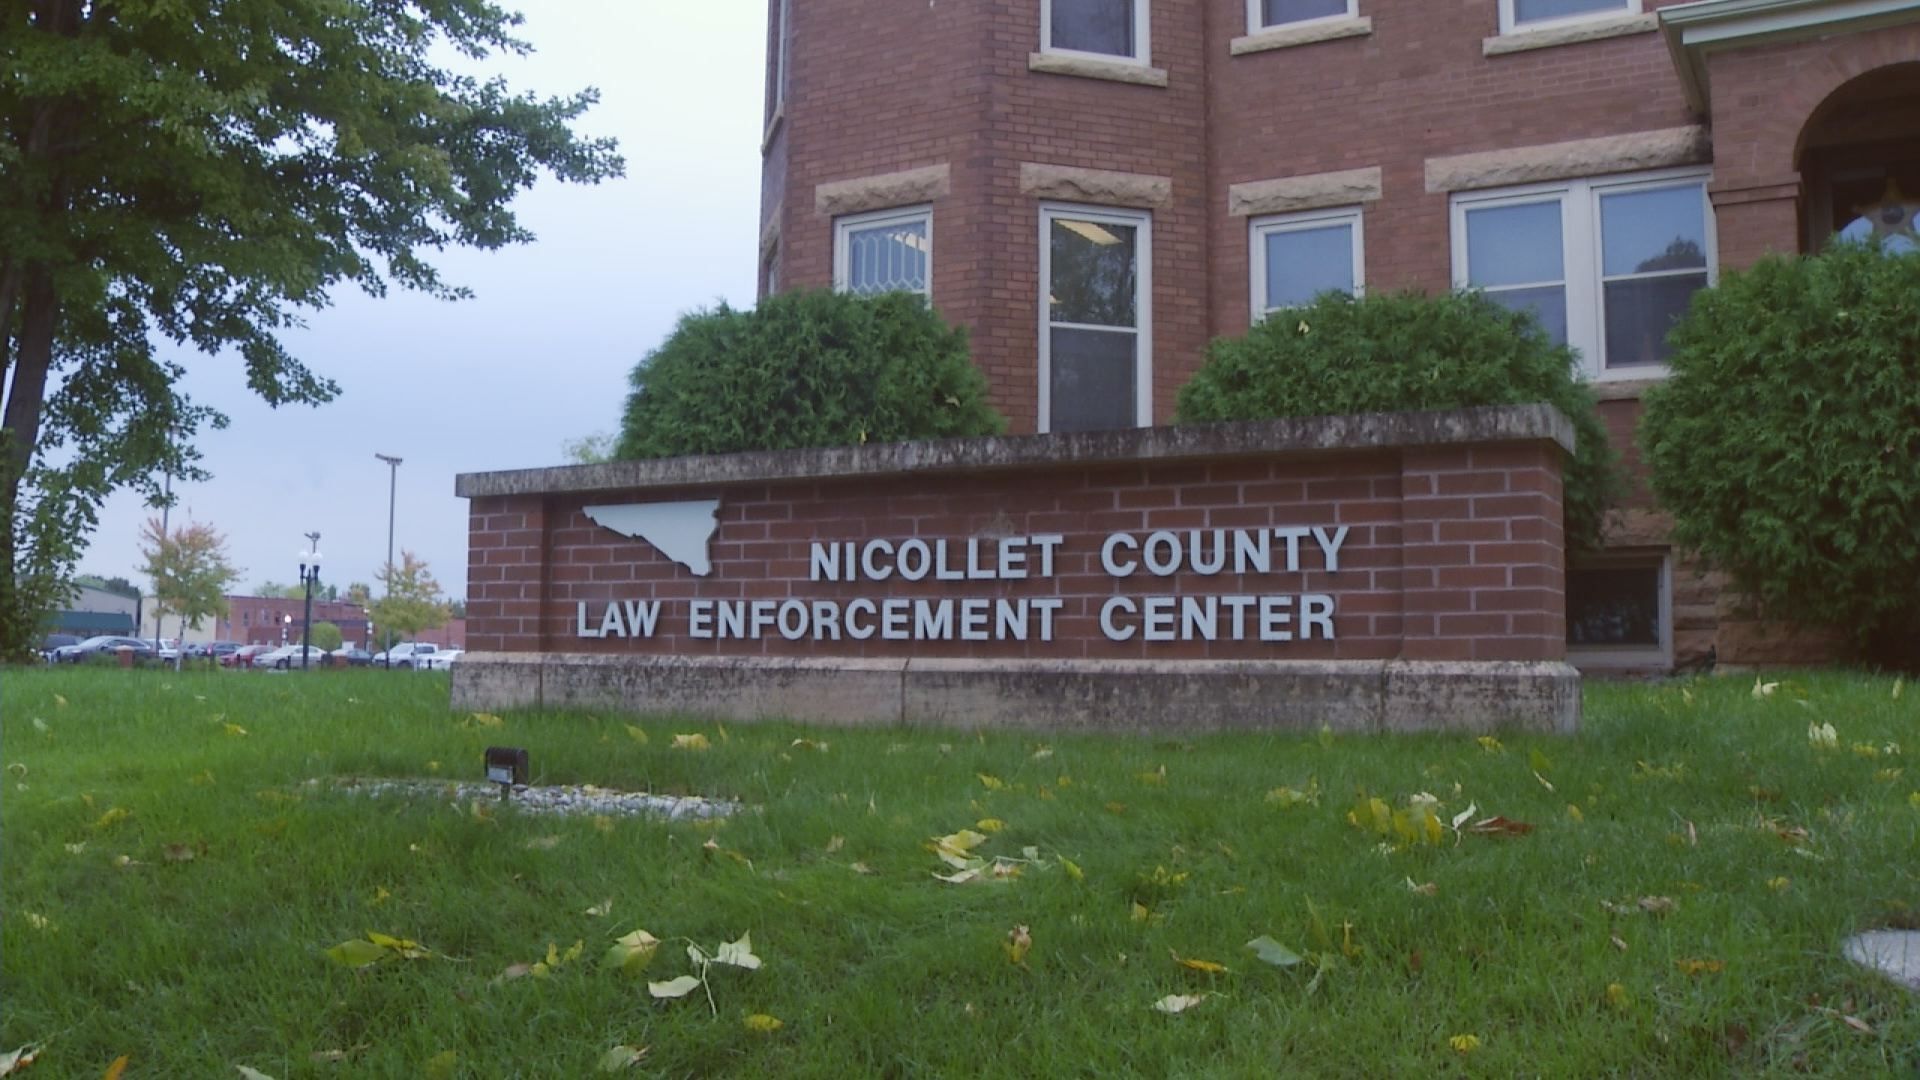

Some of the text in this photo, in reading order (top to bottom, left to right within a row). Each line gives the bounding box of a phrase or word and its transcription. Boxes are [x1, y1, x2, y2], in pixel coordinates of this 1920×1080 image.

[810, 526, 1349, 582] NICOLLET COUNTY
[577, 594, 1336, 642] LAW ENFORCEMENT CENTER
